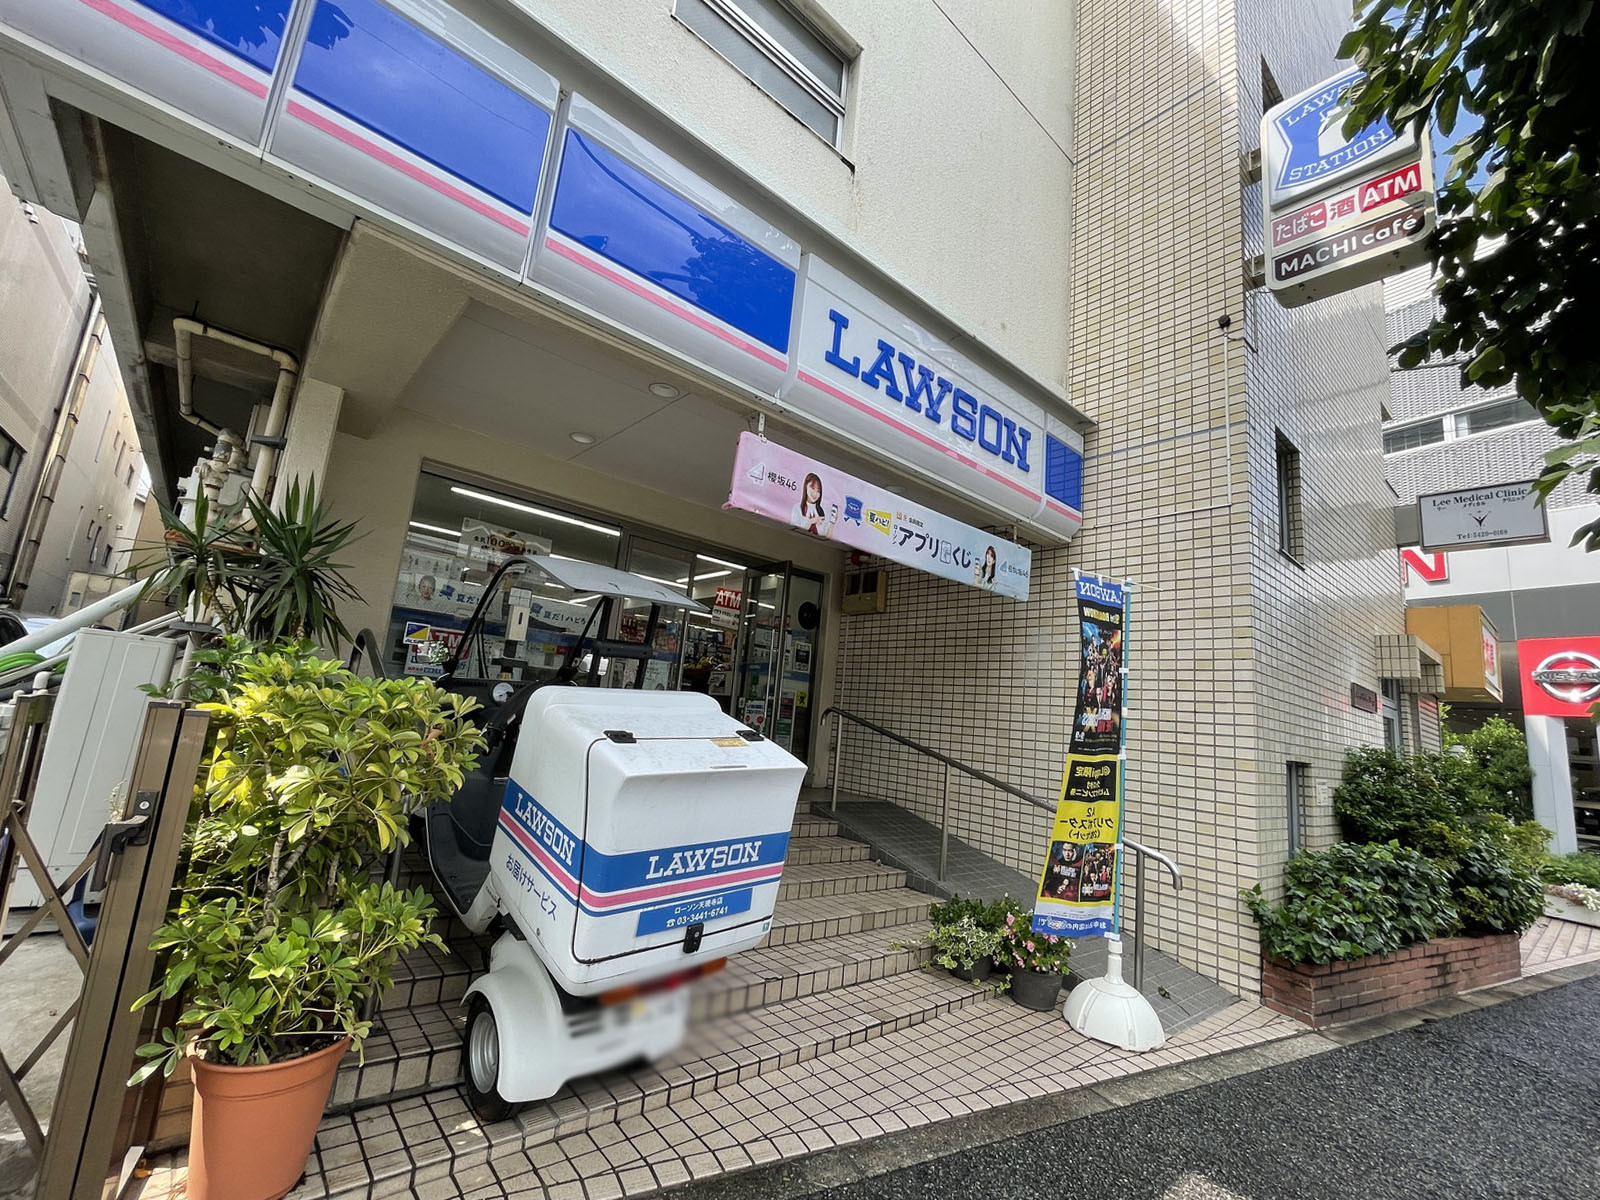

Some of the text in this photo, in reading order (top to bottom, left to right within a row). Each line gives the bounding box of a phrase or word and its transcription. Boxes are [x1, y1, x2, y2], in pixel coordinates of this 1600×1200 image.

[1288, 127, 1389, 182] STATION
[1362, 170, 1418, 208] ATM
[1275, 193, 1355, 242] たばこ 酒
[1280, 213, 1418, 277] MACHI café
[824, 308, 1032, 473] LAWSON
[1432, 487, 1528, 508] Lee Medical Clinic
[898, 526, 972, 569] アプリ くじ
[715, 589, 742, 609] ATM
[514, 791, 577, 867] LAWSON
[645, 840, 762, 881] LAWSON
[504, 852, 559, 922] お届けサービス
[676, 905, 729, 926] 03-3441-6741
